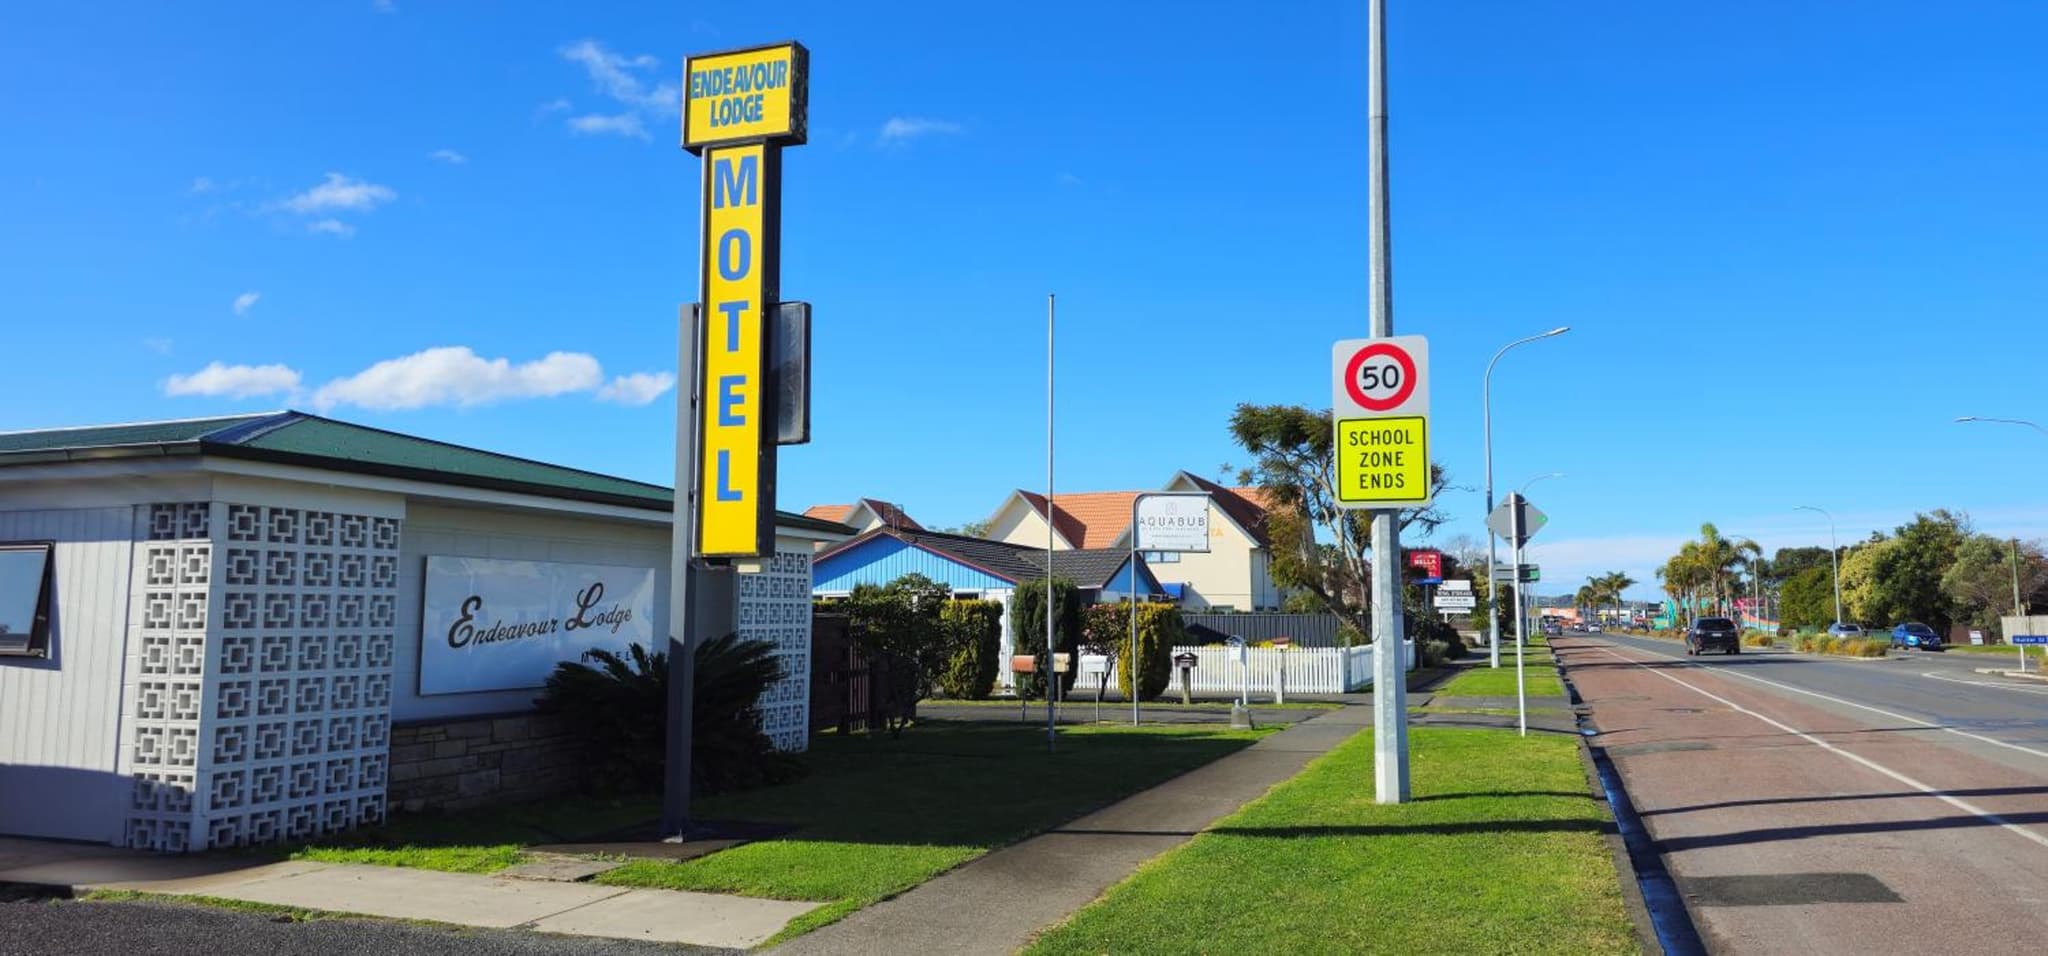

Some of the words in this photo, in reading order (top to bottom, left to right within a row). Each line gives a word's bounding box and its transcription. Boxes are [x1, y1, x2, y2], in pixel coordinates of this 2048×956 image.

[690, 60, 787, 99] ENDEAVOUR
[710, 94, 764, 128] LODGE
[713, 155, 758, 503] MOTEL
[1362, 364, 1400, 390] 50
[1349, 429, 1414, 447] SCHOOL
[1359, 451, 1405, 468] ZONE
[1359, 473, 1405, 489] ENDS
[1139, 516, 1206, 527] AQUABUB
[447, 595, 559, 649] Endeavour
[565, 582, 632, 634] Lodge
